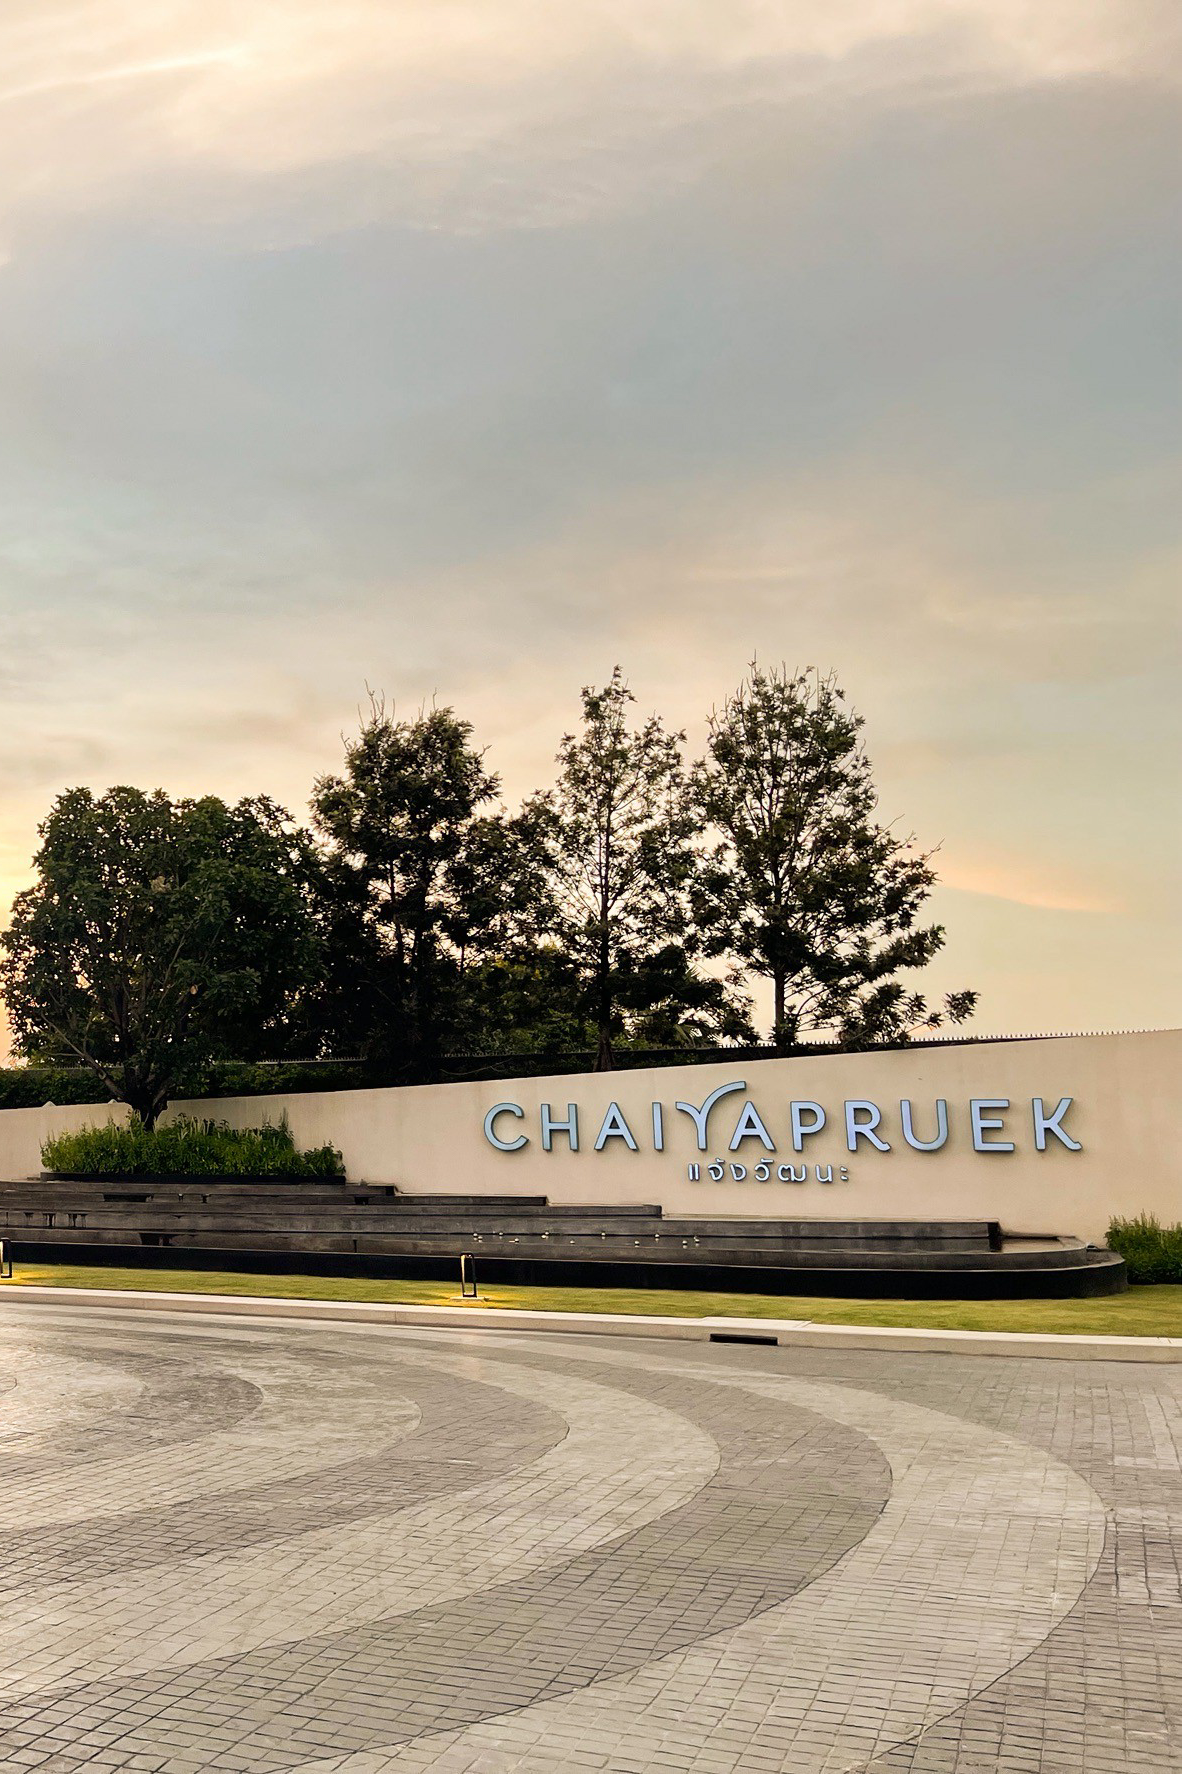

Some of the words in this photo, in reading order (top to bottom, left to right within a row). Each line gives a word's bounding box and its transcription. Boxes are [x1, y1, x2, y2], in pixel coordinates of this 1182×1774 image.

[483, 1081, 1083, 1152] CHAIYAPRUEK
[687, 1158, 850, 1183] แจ้งวัฒนะ
